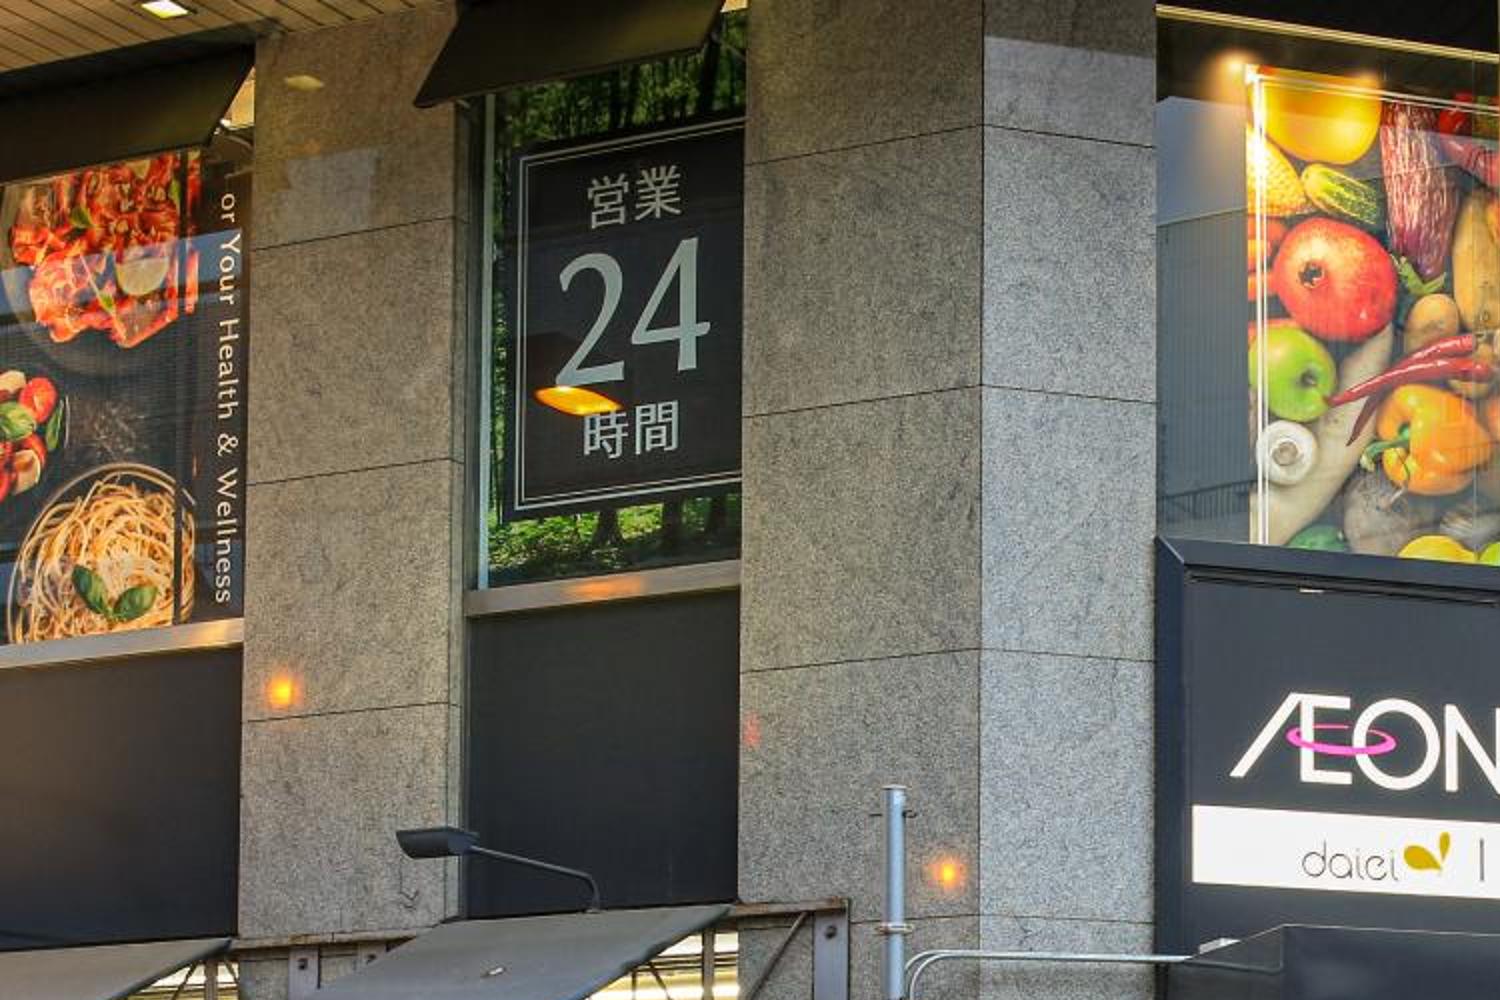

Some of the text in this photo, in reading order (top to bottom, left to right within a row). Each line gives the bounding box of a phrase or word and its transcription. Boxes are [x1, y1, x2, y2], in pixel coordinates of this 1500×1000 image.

[587, 165, 682, 229] 営業
[219, 232, 241, 305] Your
[555, 236, 711, 387] 24
[217, 320, 239, 420] Health
[216, 434, 238, 456] &
[583, 400, 679, 459] 時間
[215, 467, 238, 604] Wellness
[1301, 841, 1399, 881] daiei
